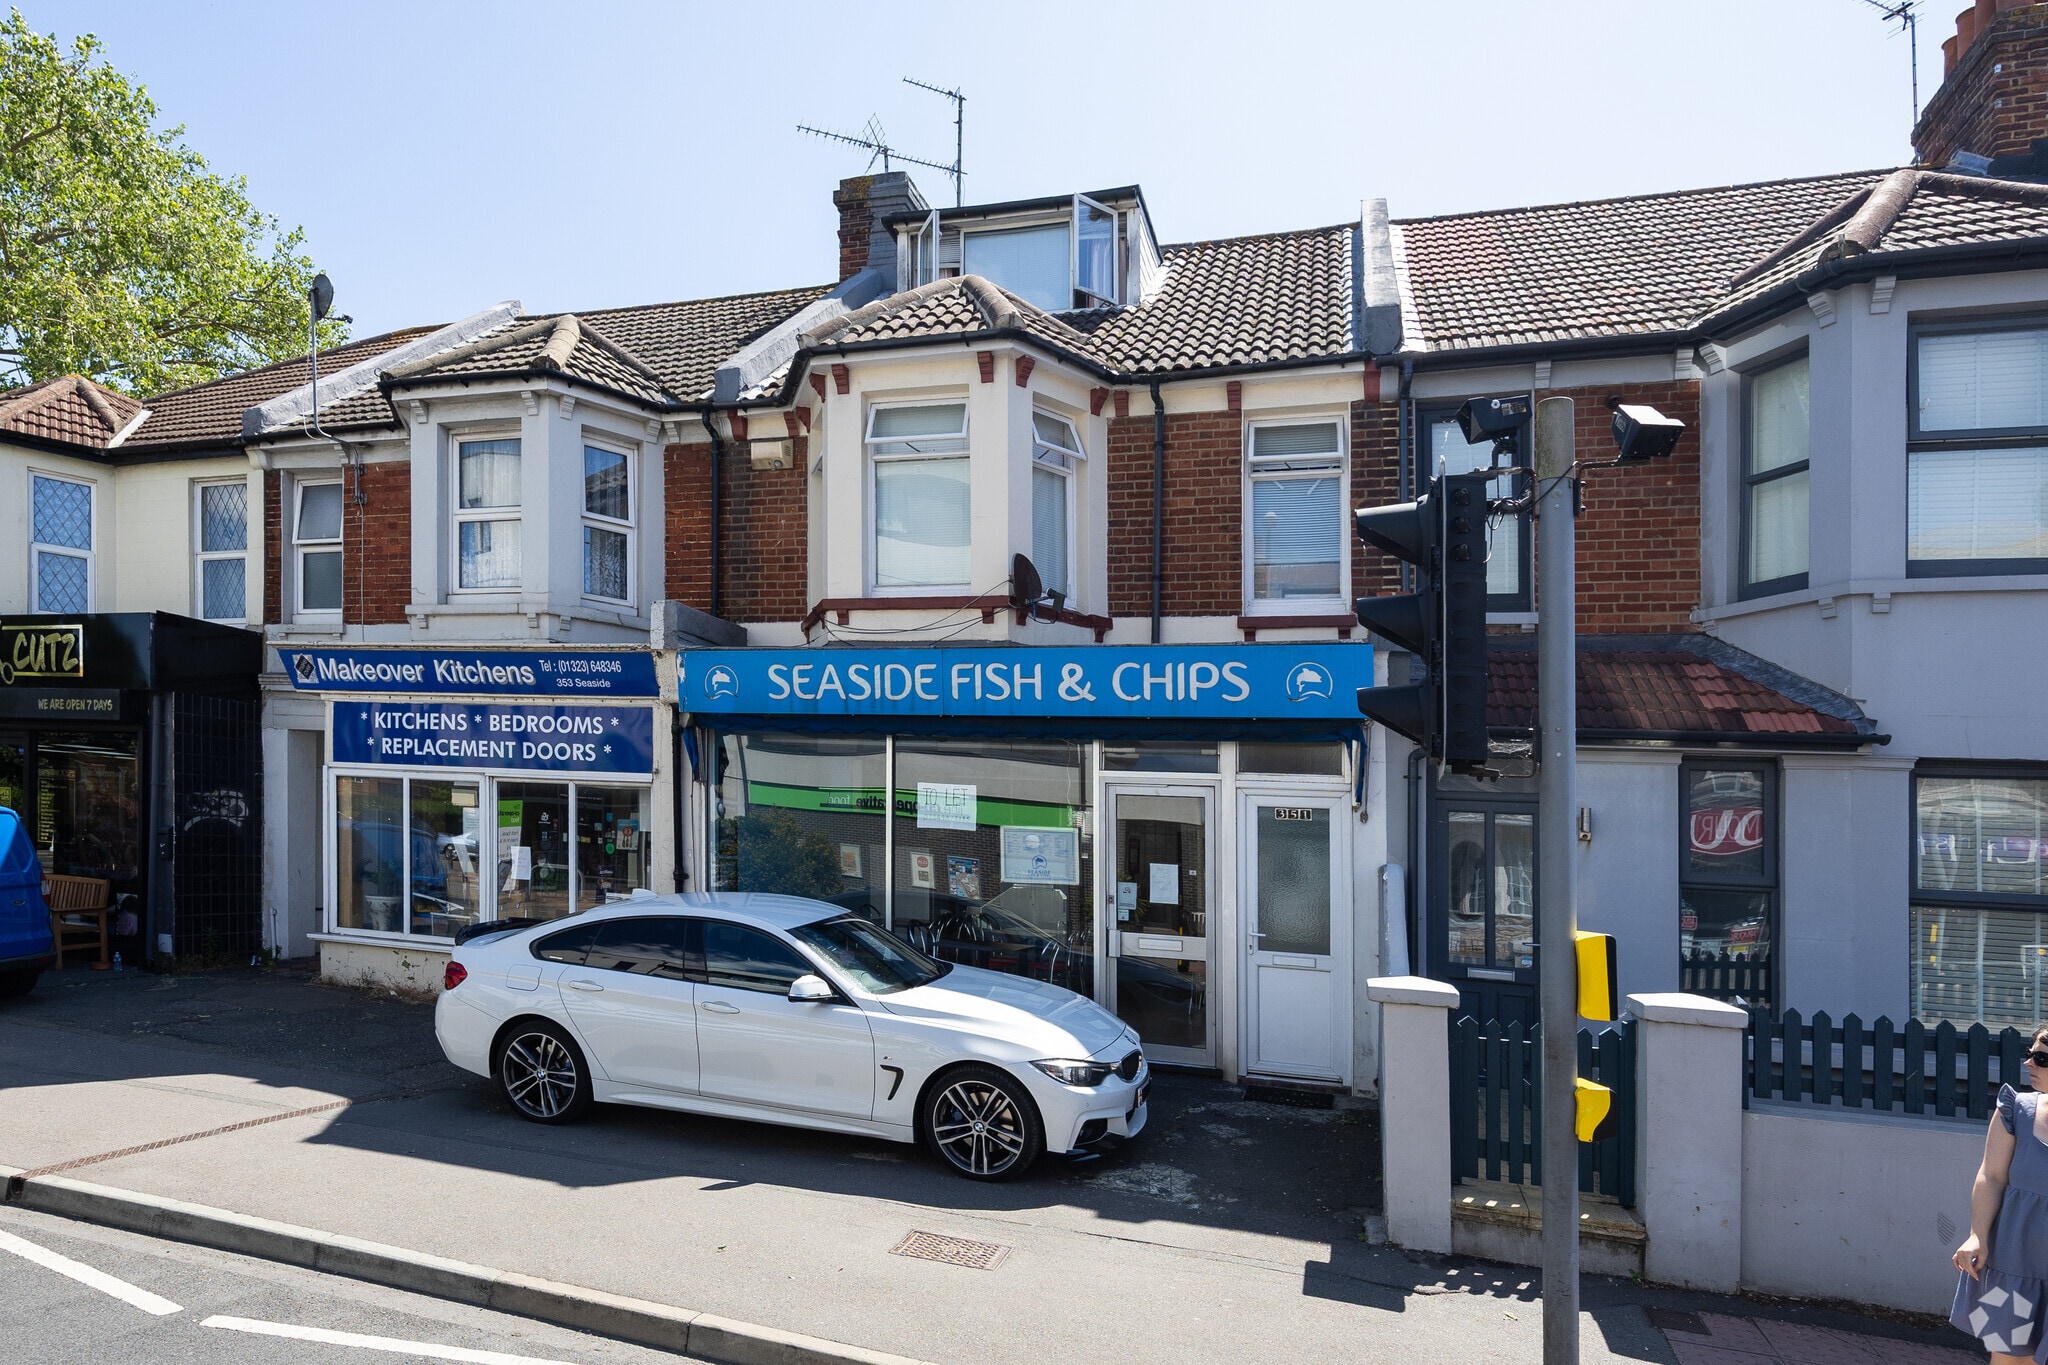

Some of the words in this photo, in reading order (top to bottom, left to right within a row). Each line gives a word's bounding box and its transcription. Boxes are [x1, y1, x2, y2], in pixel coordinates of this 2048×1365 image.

[13, 632, 79, 672] CUTZ
[316, 656, 425, 684] Makeover
[432, 657, 536, 686] Kitchens
[539, 660, 552, 672] Tel
[558, 660, 590, 674] (01323)
[590, 660, 622, 673] 648346
[556, 678, 574, 687] 353
[575, 678, 611, 688] Seaside
[768, 663, 940, 701] SEASIDE
[951, 662, 1042, 702] FISH
[1057, 661, 1096, 703] &
[1111, 661, 1251, 703] CHIPS
[38, 699, 48, 710] WE
[49, 699, 65, 710] ARE
[66, 699, 86, 711] OPEN
[86, 699, 92, 711] 7
[93, 700, 113, 711] DAYS
[374, 711, 468, 731] KITCHENS
[489, 714, 604, 735] BEDROOMS
[381, 737, 516, 759] REPLACEMENT
[522, 741, 597, 762] DOORS
[923, 787, 938, 806] TO
[945, 788, 968, 806] LET
[1278, 810, 1307, 819] 351
